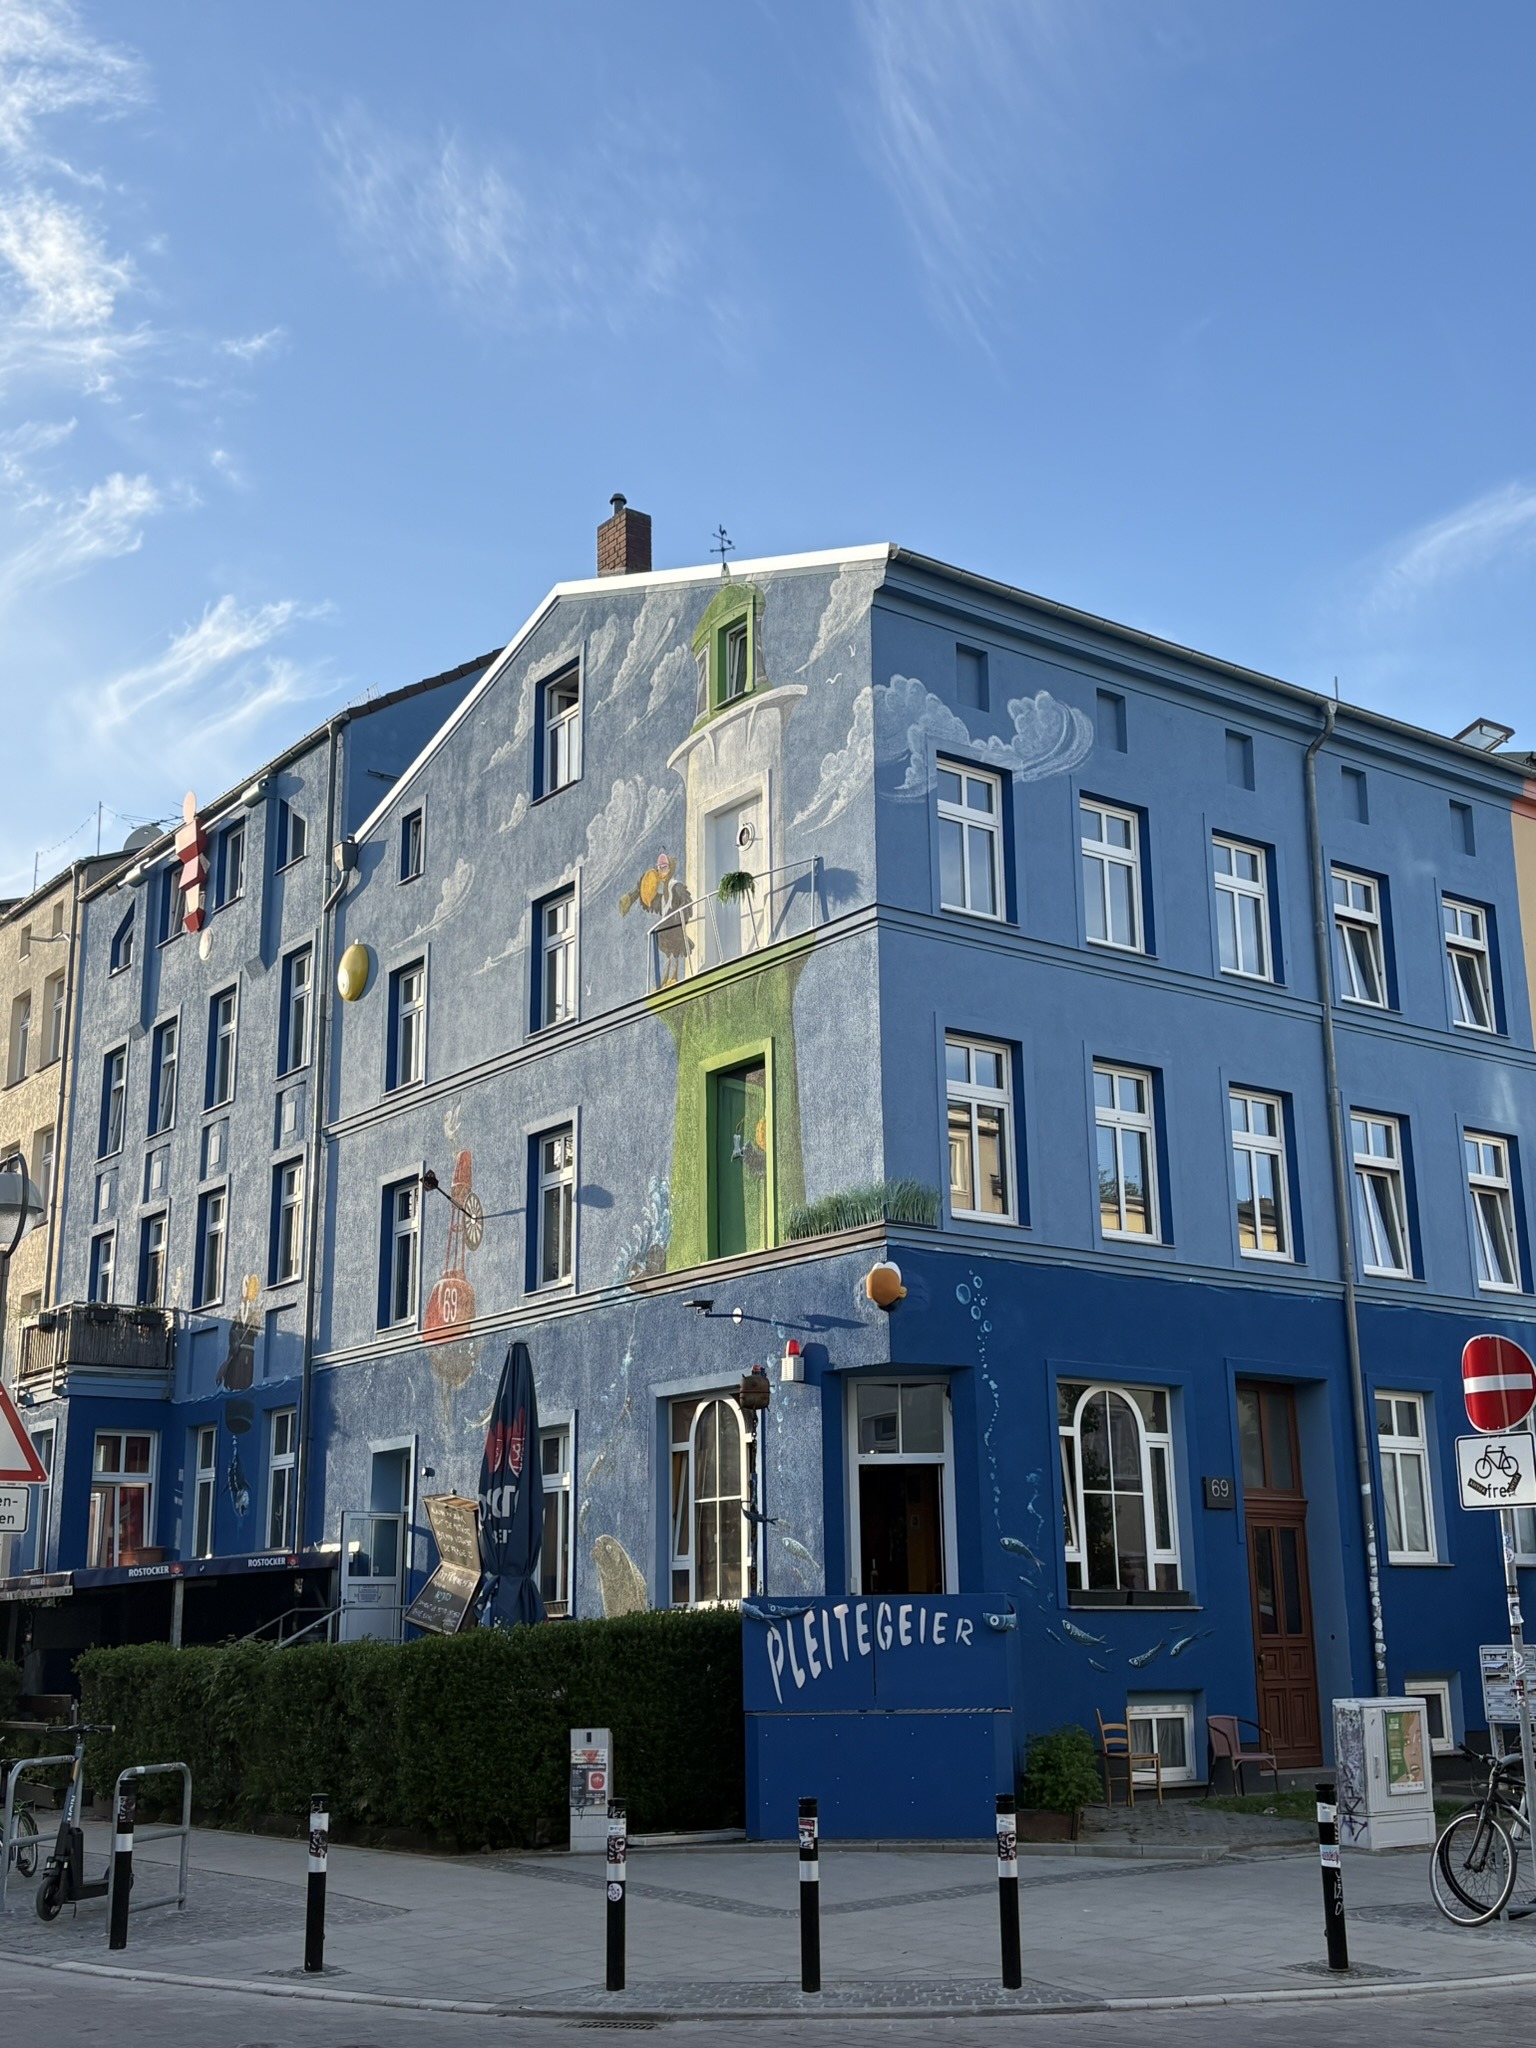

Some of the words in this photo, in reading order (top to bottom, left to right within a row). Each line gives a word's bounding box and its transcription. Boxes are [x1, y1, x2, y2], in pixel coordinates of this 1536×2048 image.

[443, 1288, 458, 1323] 69
[1211, 1479, 1229, 1497] 69
[128, 1565, 169, 1577] ROSTOCKER
[248, 1557, 286, 1567] ROSTOCKER
[766, 1601, 974, 1704] PLEITEGEIER
